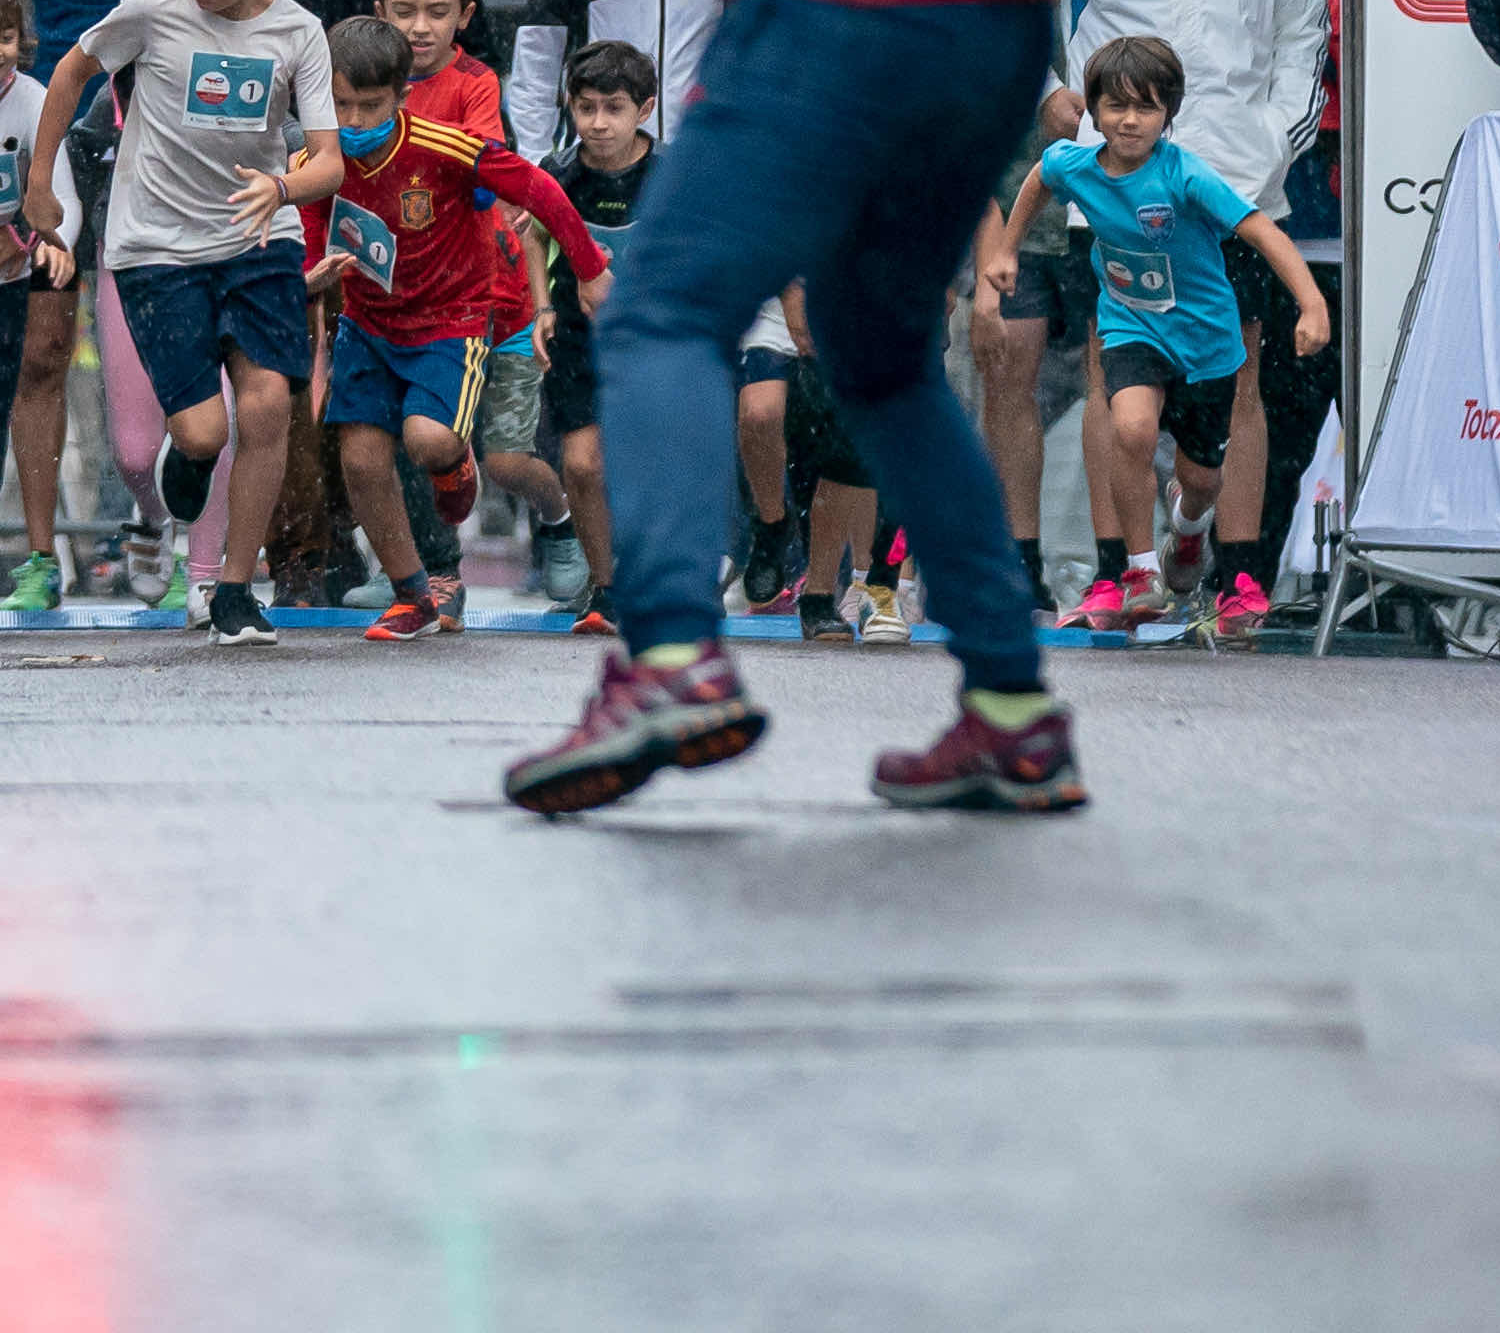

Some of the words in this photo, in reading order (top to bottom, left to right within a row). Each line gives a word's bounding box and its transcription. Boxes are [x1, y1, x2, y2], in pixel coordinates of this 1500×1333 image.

[246, 83, 255, 100] 1
[373, 245, 381, 261] 1
[1147, 273, 1156, 287] 1
